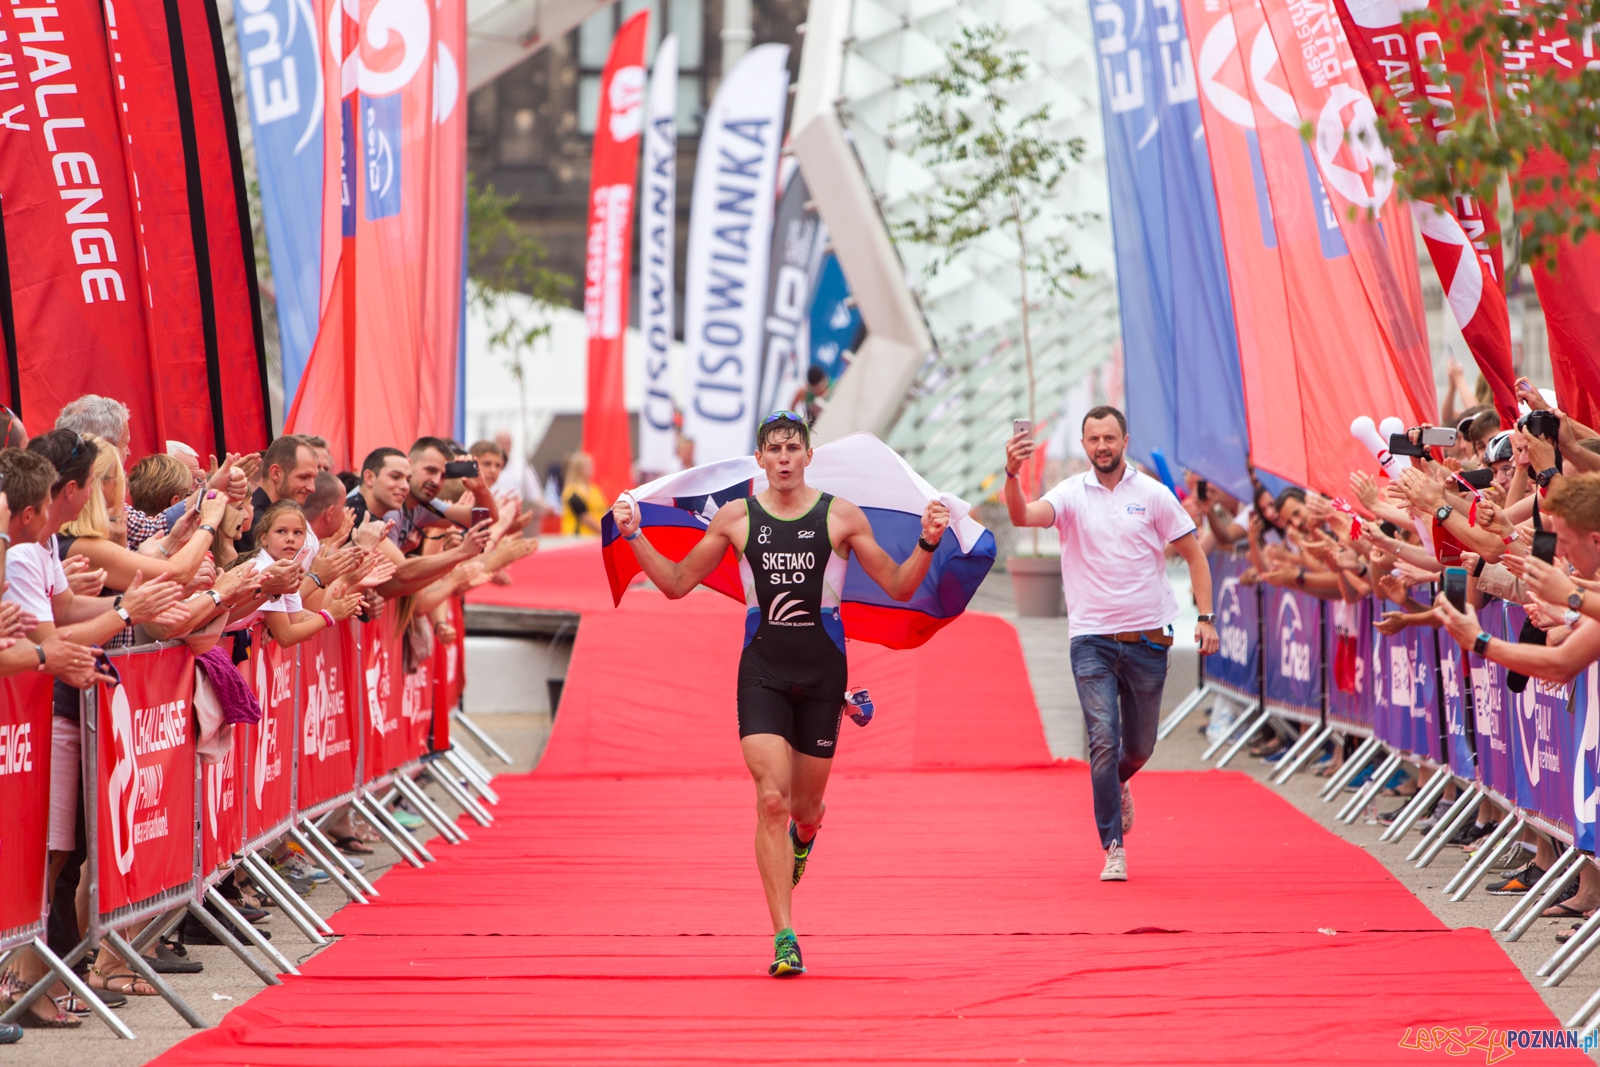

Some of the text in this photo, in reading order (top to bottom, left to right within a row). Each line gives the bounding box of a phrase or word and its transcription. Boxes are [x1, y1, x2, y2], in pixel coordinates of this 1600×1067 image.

[10, 0, 126, 304] HALLENGE
[643, 114, 677, 434] CISOWIANKA
[694, 117, 771, 423] CISOWIANKA
[762, 552, 816, 570] SKETAKO
[770, 571, 806, 585] SLO
[134, 699, 187, 756] CHALLENGE
[135, 763, 164, 811] FAMILY
